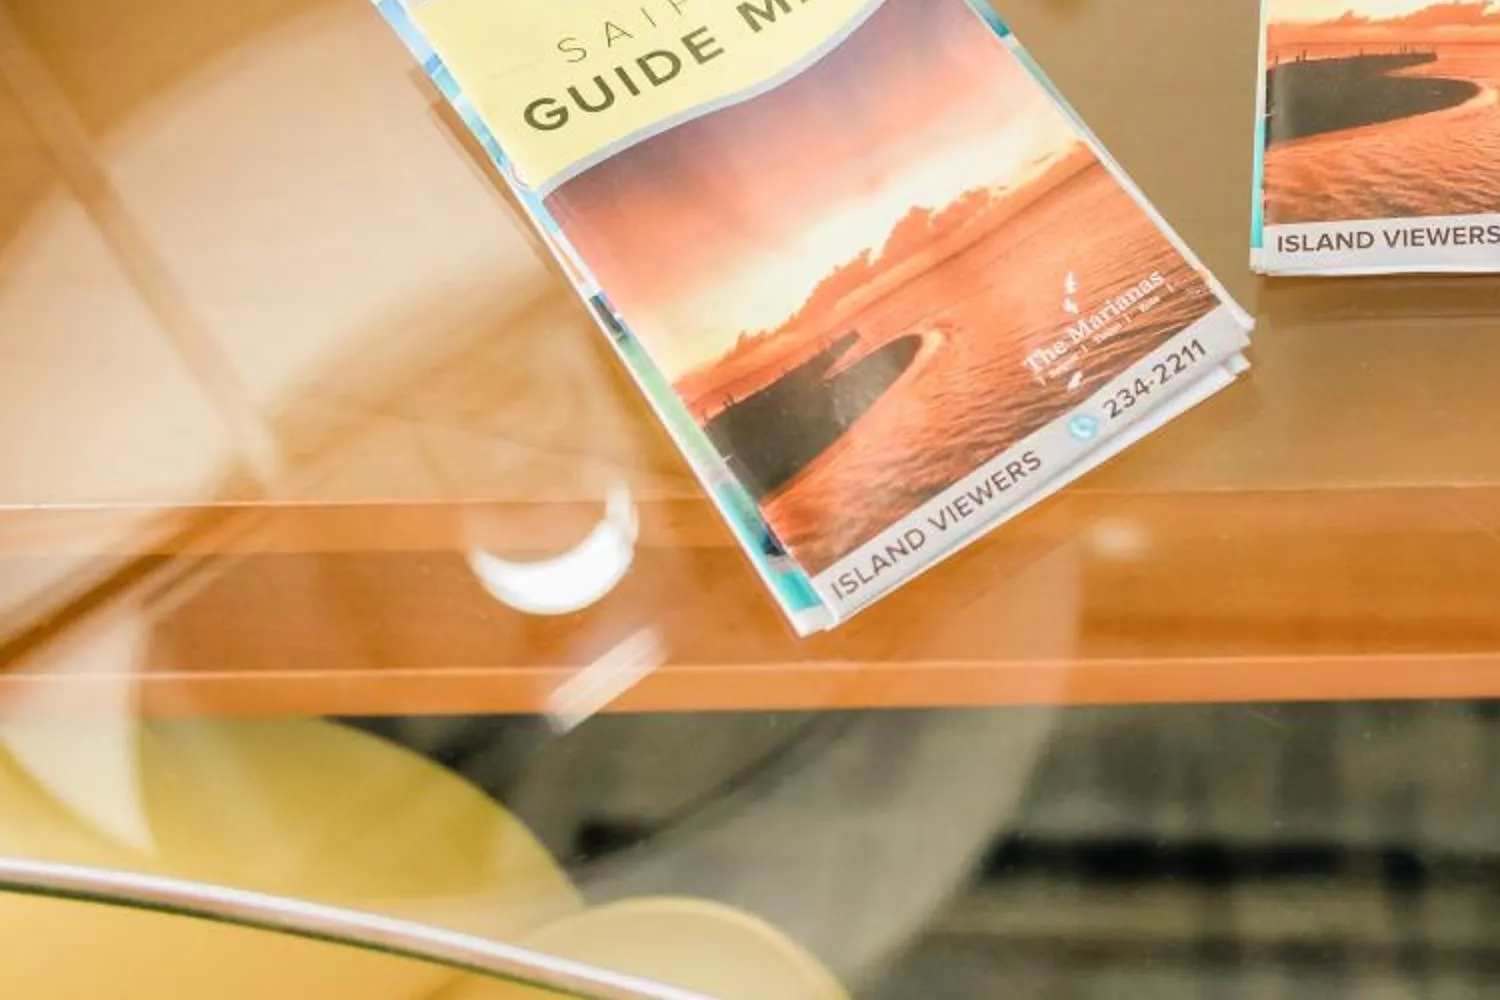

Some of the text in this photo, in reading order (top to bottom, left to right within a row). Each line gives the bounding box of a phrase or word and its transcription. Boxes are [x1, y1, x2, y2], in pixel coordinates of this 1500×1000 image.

[523, 26, 725, 133] GUIDE
[1277, 229, 1376, 254] ISLAND
[1023, 341, 1068, 372] The
[1067, 271, 1166, 343] Marianas
[831, 526, 926, 600] ISLAND
[927, 450, 1042, 533] VIEWERS
[1102, 337, 1207, 420] 234-2211
